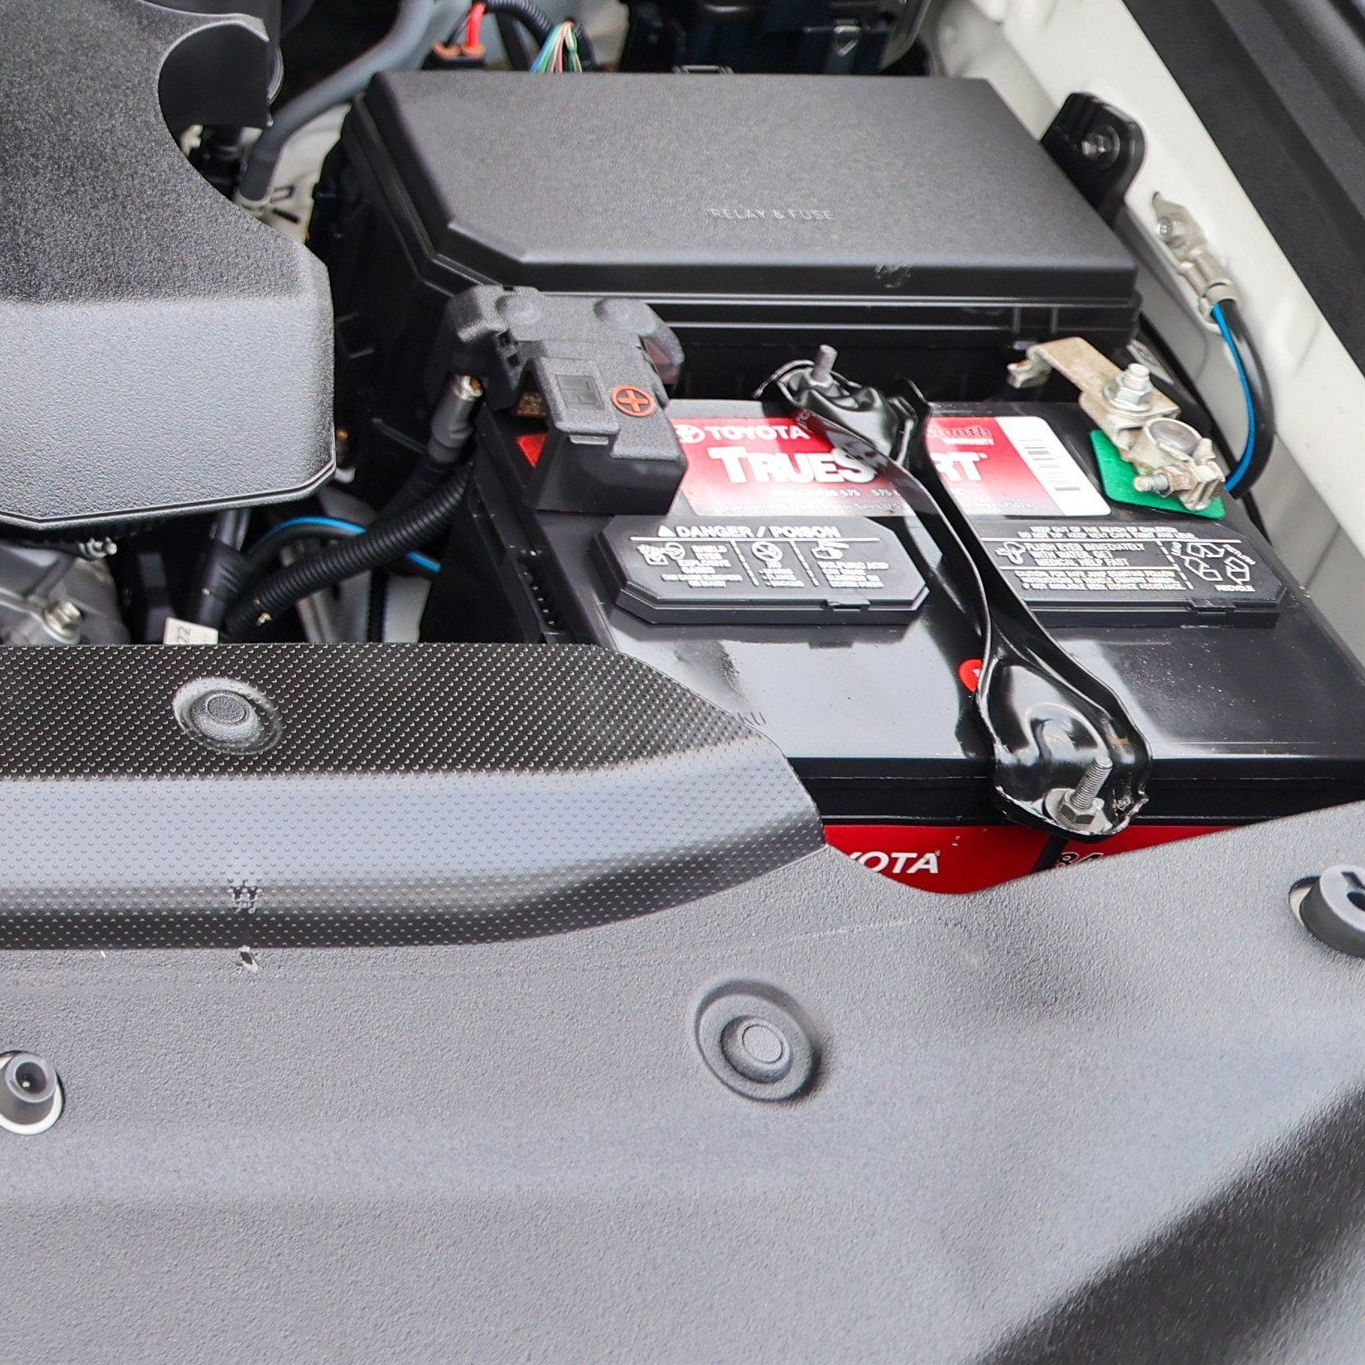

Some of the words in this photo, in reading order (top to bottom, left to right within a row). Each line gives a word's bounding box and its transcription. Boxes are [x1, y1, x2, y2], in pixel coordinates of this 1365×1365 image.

[709, 208, 766, 220] RELAY
[786, 209, 836, 221] FUSE
[704, 425, 811, 441] TOYOTA
[674, 525, 755, 538] DANGER
[768, 525, 842, 538] POISON
[1024, 542, 1059, 552] FLUSH
[1055, 542, 1085, 552] EYES
[1081, 542, 1145, 552] IMMEDIATELY
[1028, 550, 1057, 559] WITH
[1091, 550, 1113, 559] GET
[1034, 557, 1079, 567] MEDICAL
[1076, 557, 1105, 567] HELP
[1103, 557, 1130, 567] FAST
[1214, 584, 1256, 592] RECYCLE
